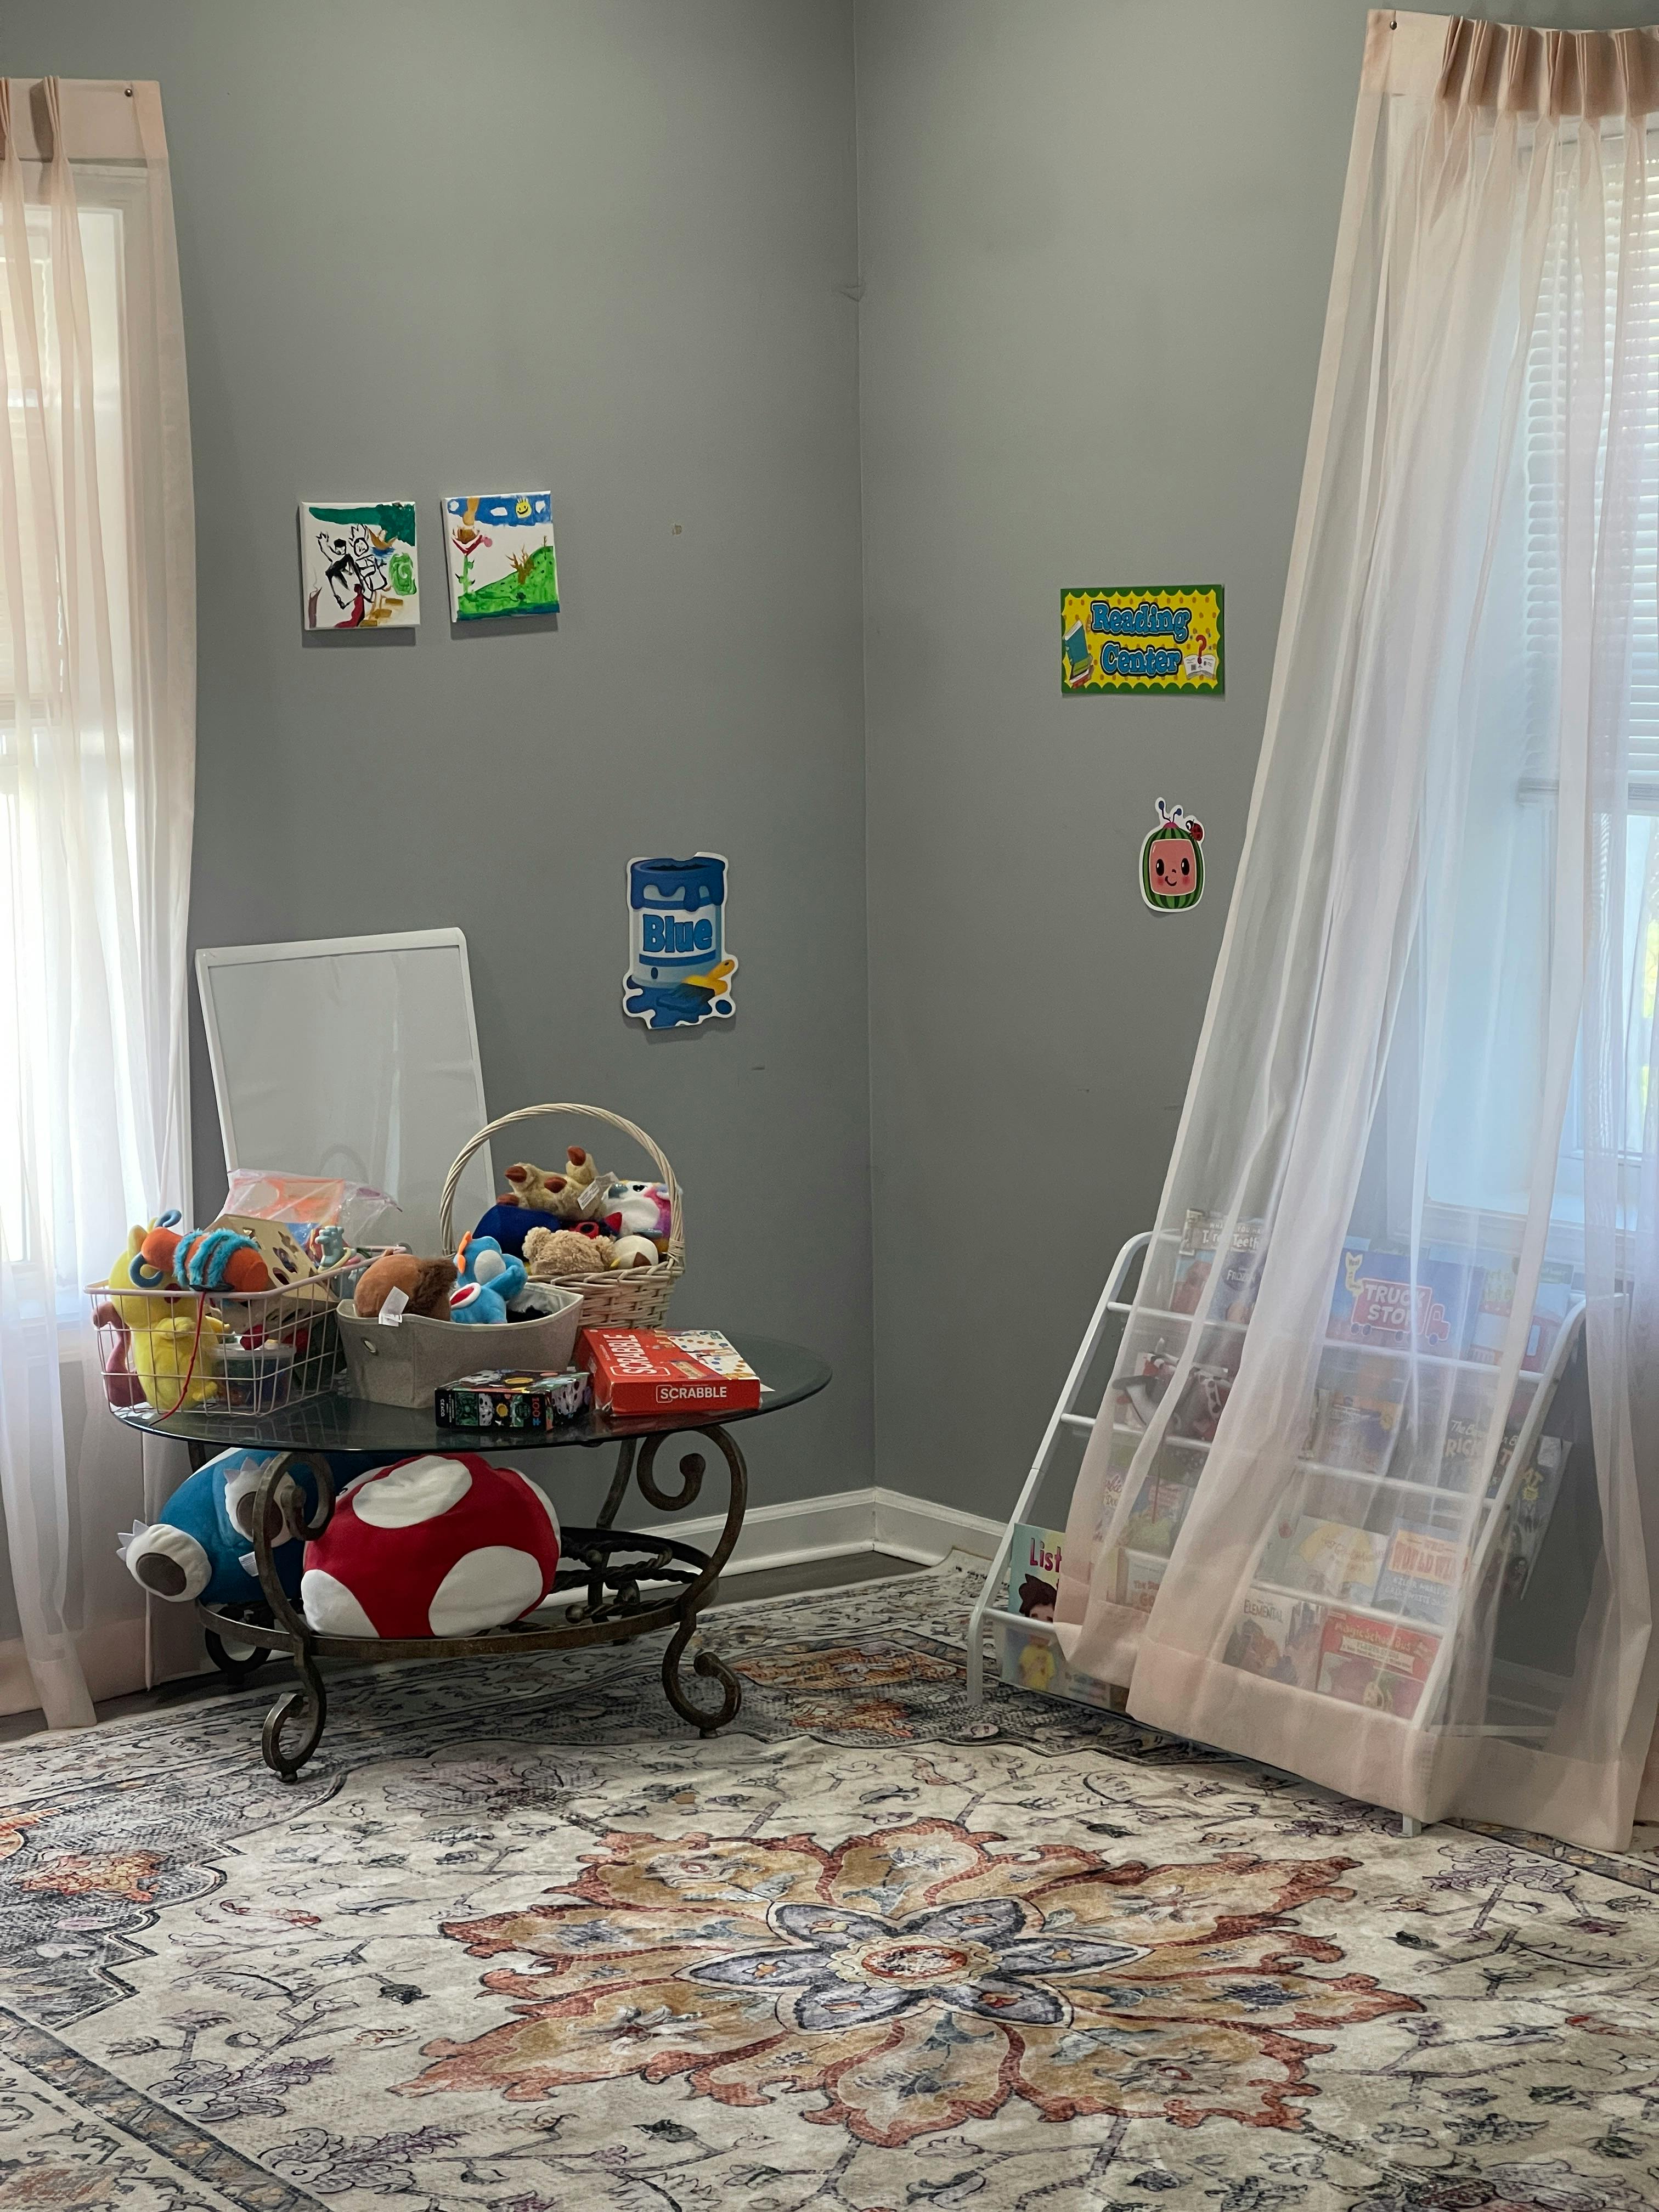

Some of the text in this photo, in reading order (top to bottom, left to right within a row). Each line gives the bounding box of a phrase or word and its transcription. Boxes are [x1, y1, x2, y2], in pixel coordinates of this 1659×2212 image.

[1091, 601, 1190, 642] Reading
[1101, 642, 1181, 676] Center
[642, 913, 712, 953] Blue
[604, 1334, 658, 1375] SCRABBLE
[660, 1386, 727, 1400] SCRABBLE
